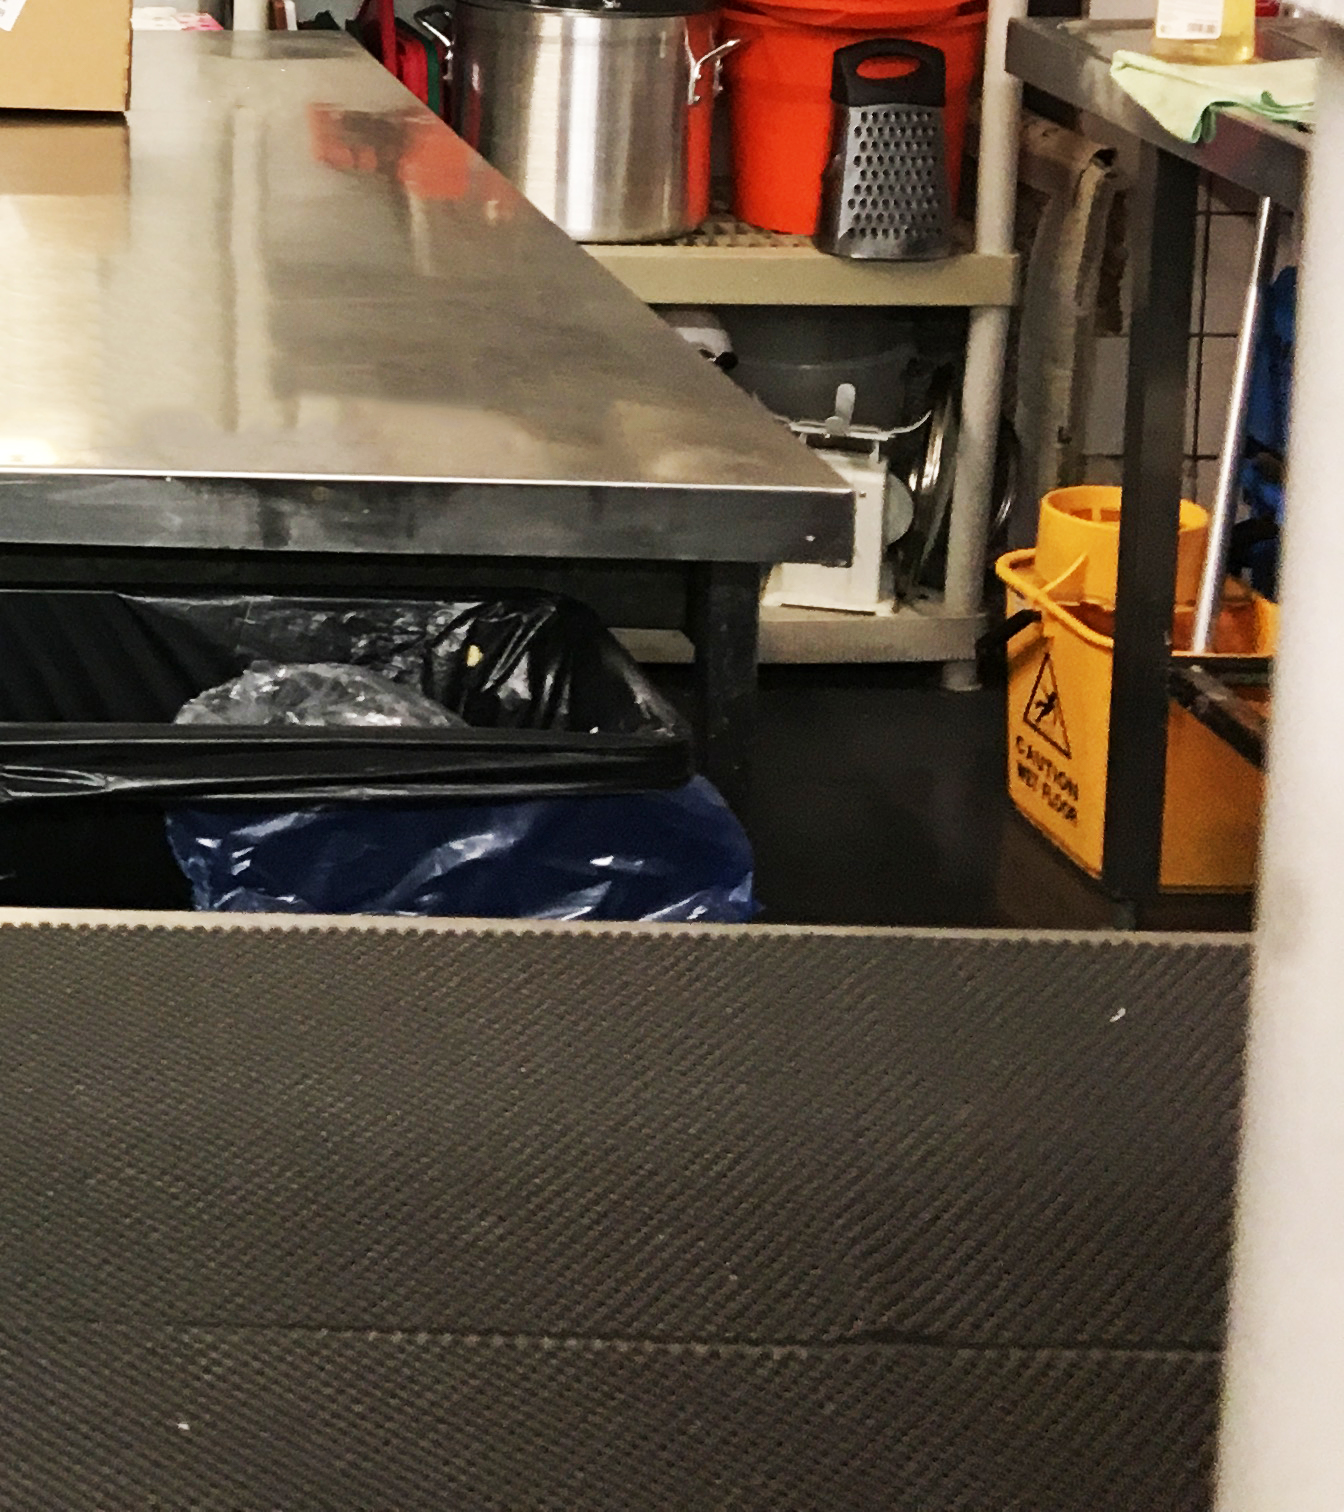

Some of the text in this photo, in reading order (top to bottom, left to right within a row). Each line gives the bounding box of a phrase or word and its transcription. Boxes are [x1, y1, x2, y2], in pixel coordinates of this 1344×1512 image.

[1015, 735, 1080, 802] CAUTION
[1016, 761, 1079, 826] WET FLOOR
